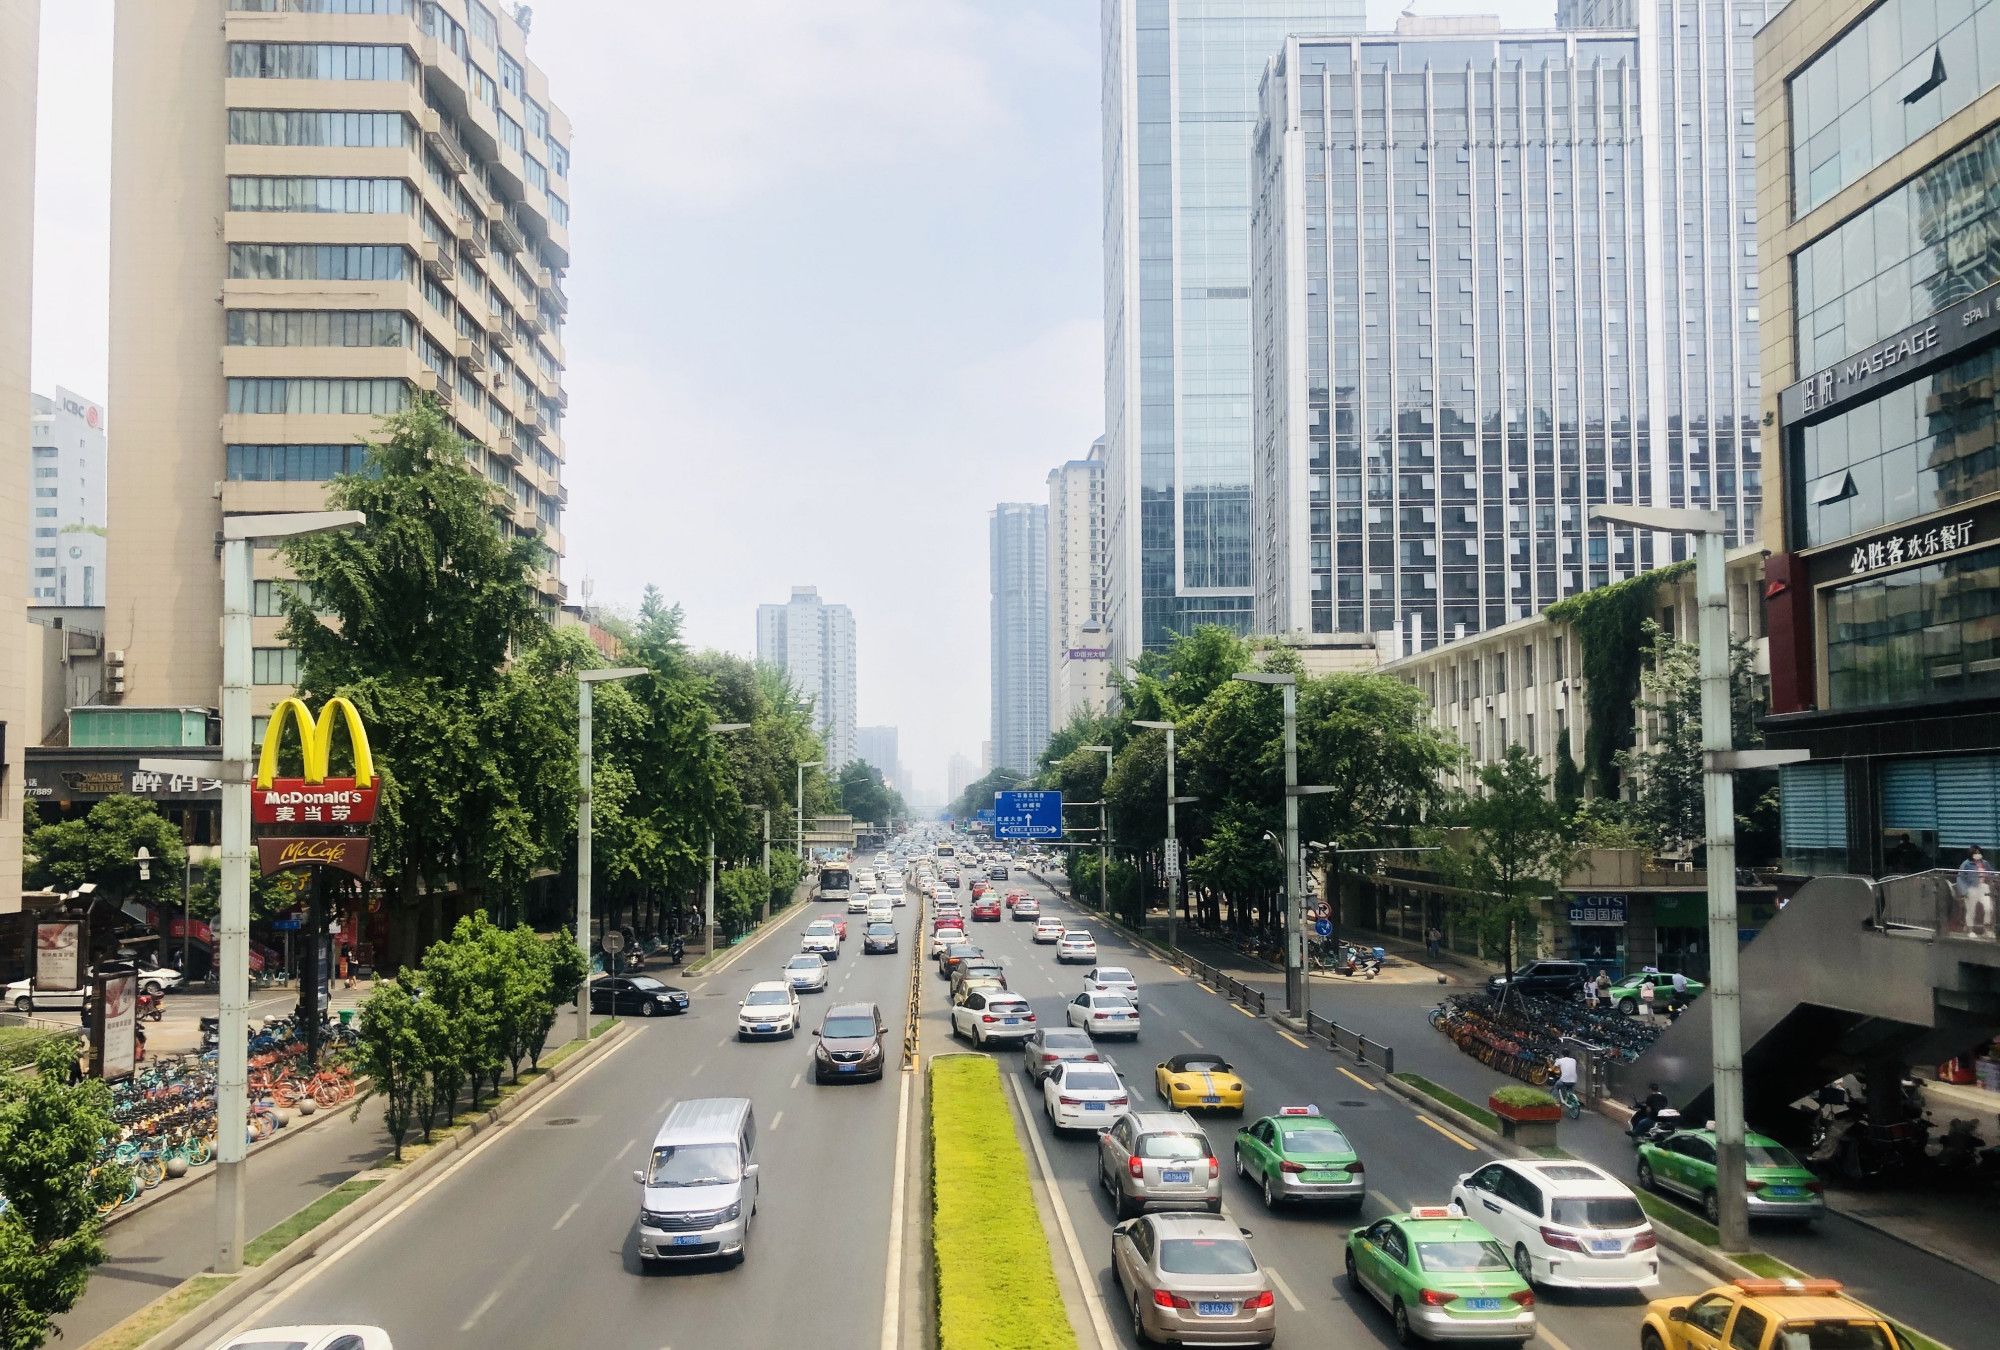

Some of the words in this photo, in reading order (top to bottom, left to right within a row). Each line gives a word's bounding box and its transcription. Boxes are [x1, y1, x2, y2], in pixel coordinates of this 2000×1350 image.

[1963, 307, 1983, 326] SPA
[1846, 325, 1937, 384] MASSAGE
[63, 397, 85, 418] ICBC
[1850, 519, 1974, 574] 必胜客欢乐餐厅
[264, 790, 362, 805] McDonald's
[275, 805, 351, 821] 麦当劳
[1587, 896, 1624, 906] CITS
[1570, 908, 1624, 921] 中国国旅
